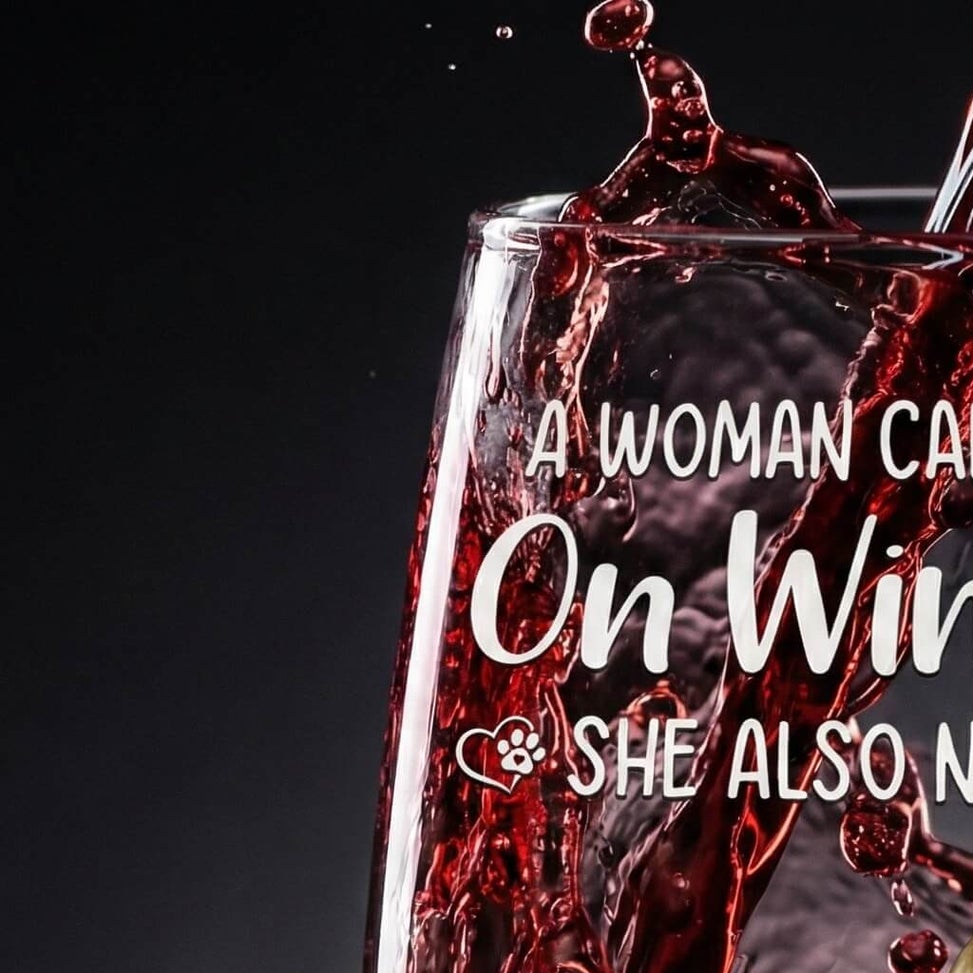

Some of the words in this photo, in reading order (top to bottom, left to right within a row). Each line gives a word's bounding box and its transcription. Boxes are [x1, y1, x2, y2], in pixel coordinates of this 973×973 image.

[524, 398, 571, 479] A
[600, 396, 854, 481] WOMAN
[469, 512, 676, 675] On
[566, 715, 702, 798] SHE
[727, 717, 905, 801] ALSO
